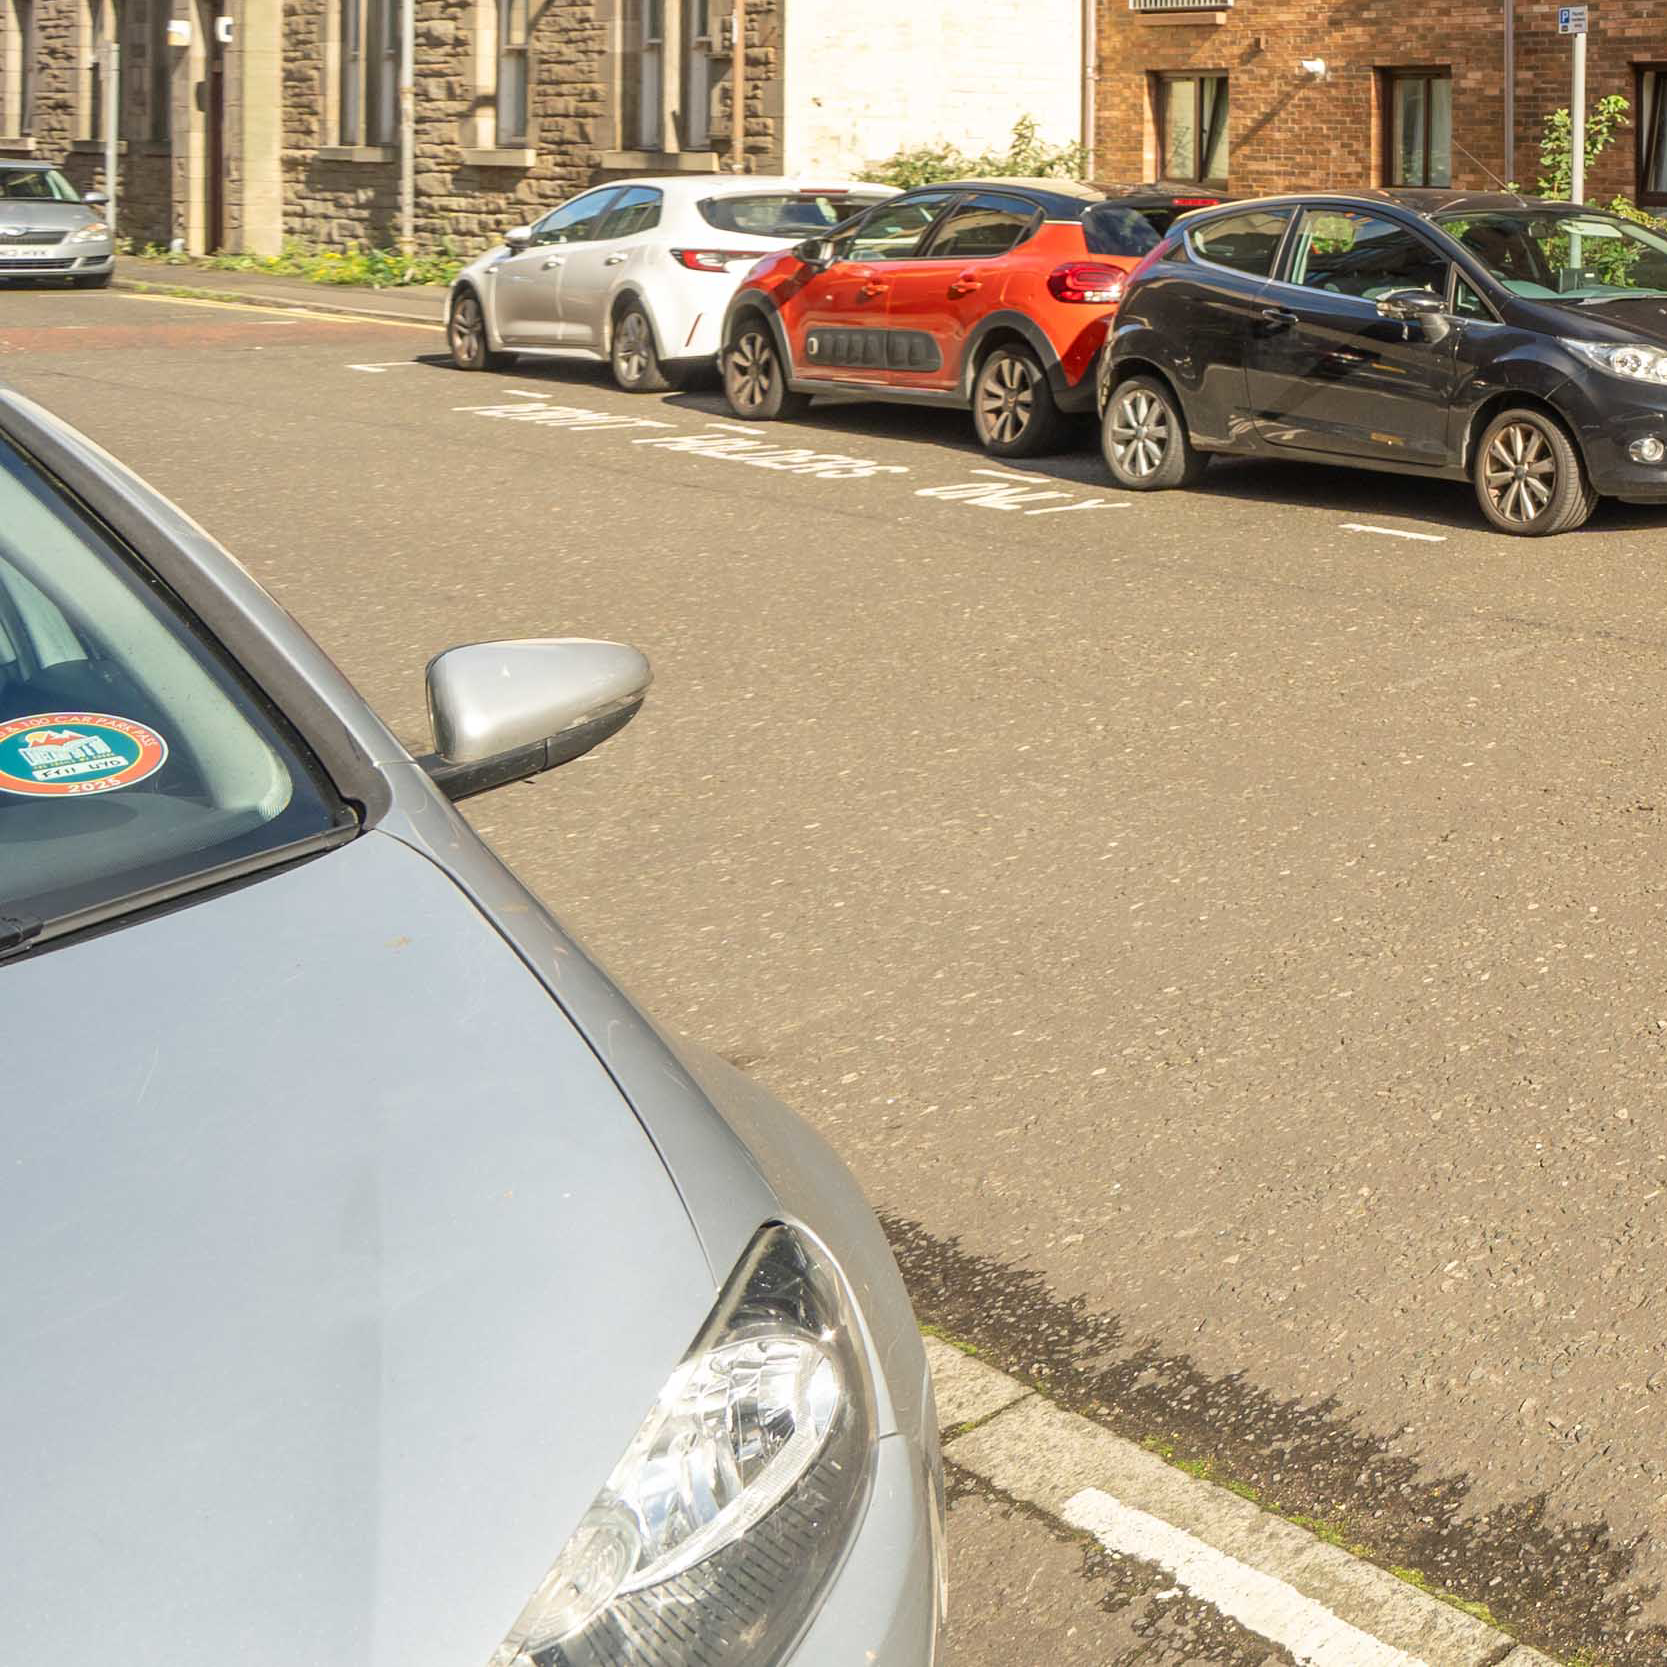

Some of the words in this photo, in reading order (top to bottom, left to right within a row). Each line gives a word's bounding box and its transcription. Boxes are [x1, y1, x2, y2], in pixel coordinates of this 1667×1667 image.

[451, 402, 678, 431] PERMIT
[631, 433, 909, 479] HOLDERS
[914, 482, 1132, 515] ONLY
[54, 716, 92, 724] CAR
[67, 778, 121, 793] 2025
